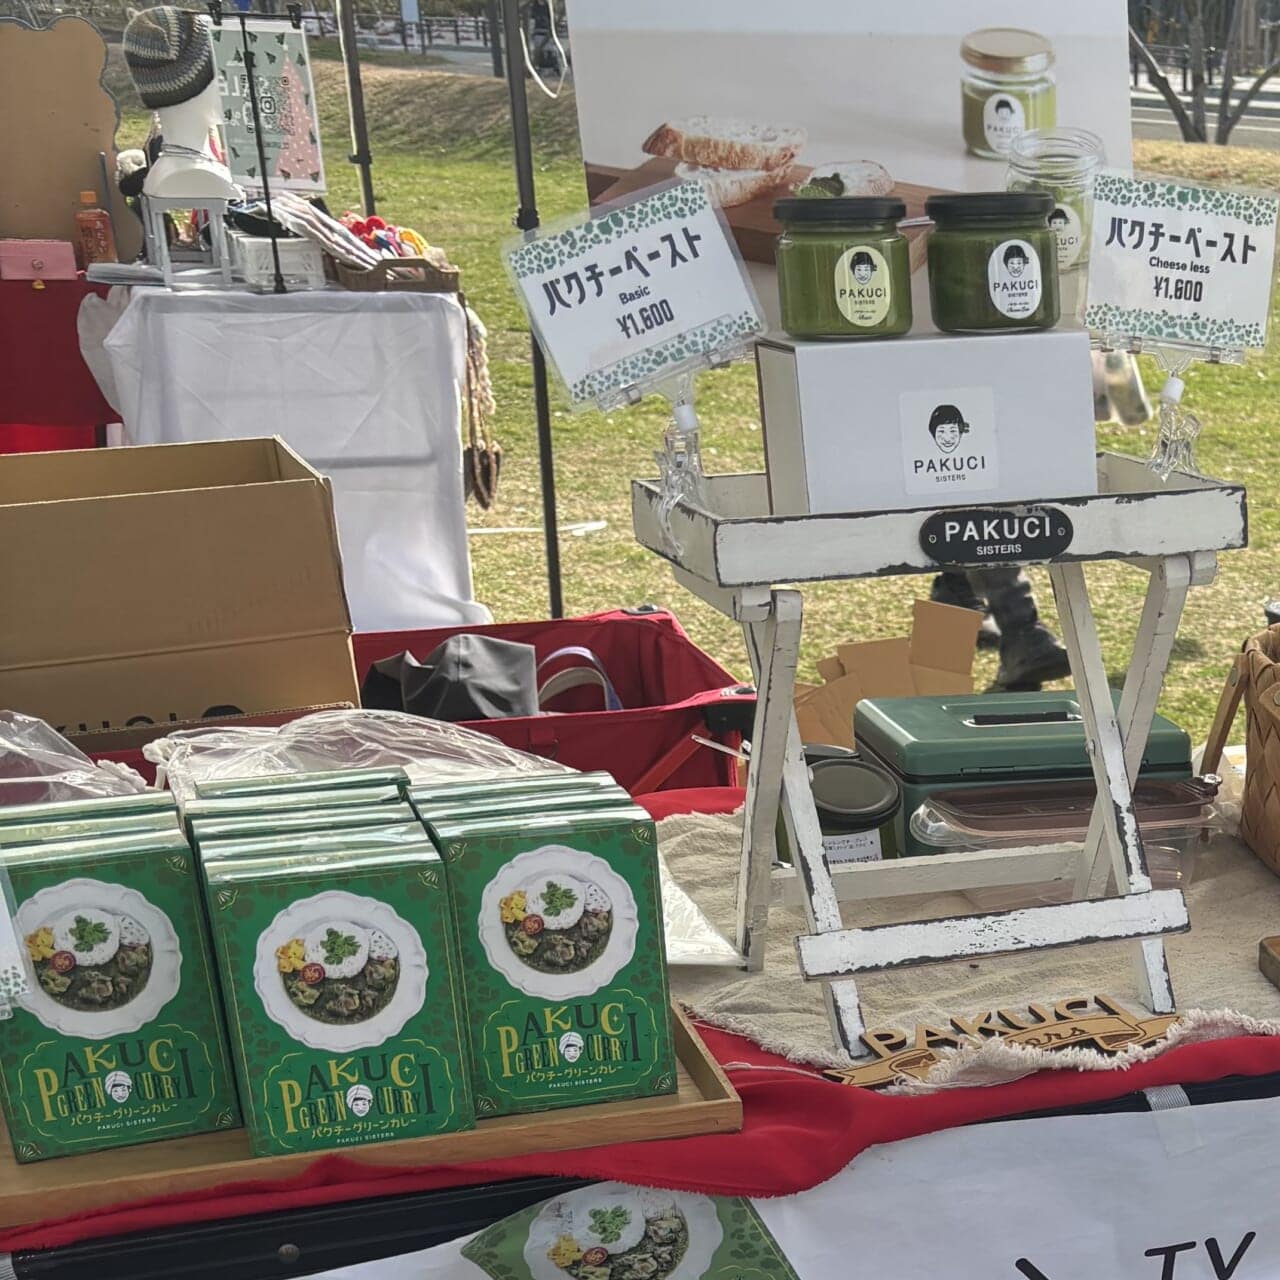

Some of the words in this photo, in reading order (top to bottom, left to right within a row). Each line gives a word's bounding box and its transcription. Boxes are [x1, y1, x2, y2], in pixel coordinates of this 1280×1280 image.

[1105, 216, 1258, 265] パクチーペースト
[541, 226, 702, 316] パクチーペースト
[1149, 256, 1188, 272] Cheese
[1189, 260, 1211, 274] less
[618, 285, 651, 305] Basic
[839, 287, 887, 299] PAKUCI
[993, 279, 1038, 292] PAKUCI
[1153, 275, 1204, 302] ¥1,600
[615, 298, 675, 339] ¥1,600
[914, 455, 986, 474] PAKUCI
[935, 473, 967, 483] SISTERS
[944, 516, 1052, 543] PAKUCI
[976, 543, 1023, 556] SISTERS
[859, 994, 1138, 1060] PAKUCI
